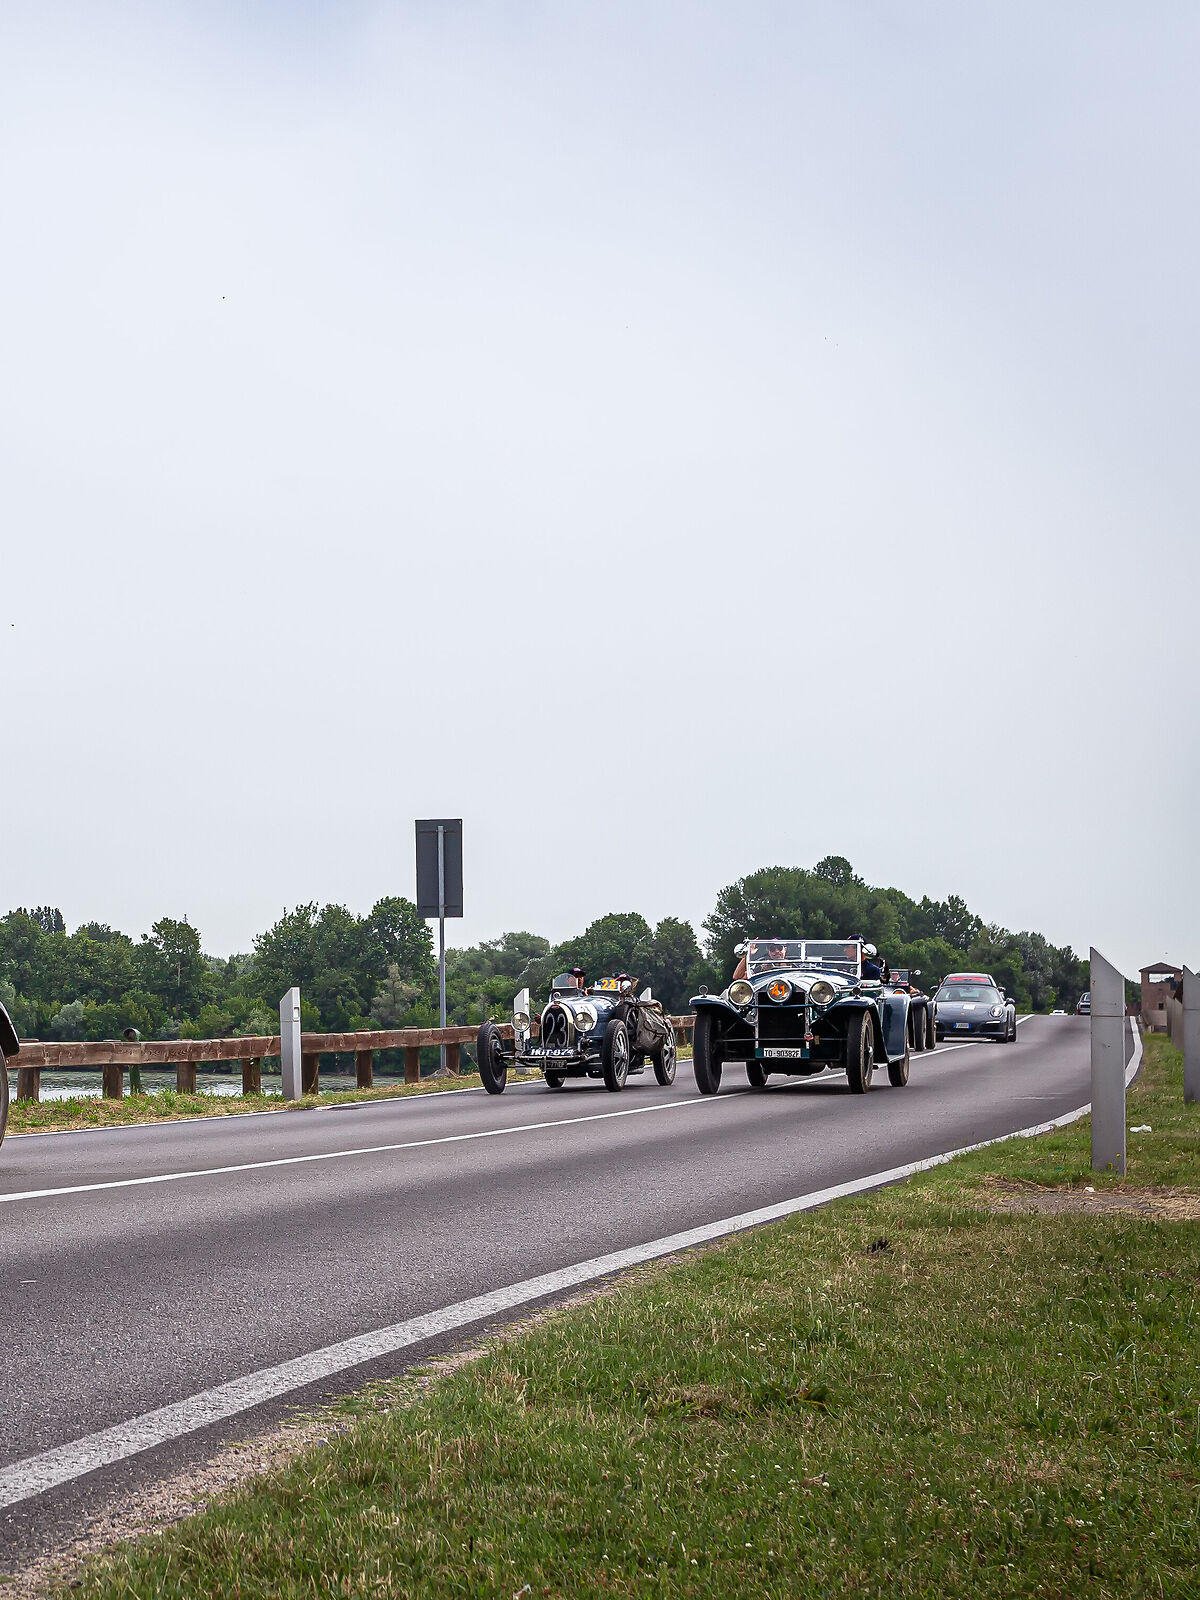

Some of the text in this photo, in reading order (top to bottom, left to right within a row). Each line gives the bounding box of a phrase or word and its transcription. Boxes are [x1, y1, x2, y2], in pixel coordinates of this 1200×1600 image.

[601, 979, 617, 990] 23
[770, 984, 786, 997] 41
[545, 1012, 567, 1048] 23
